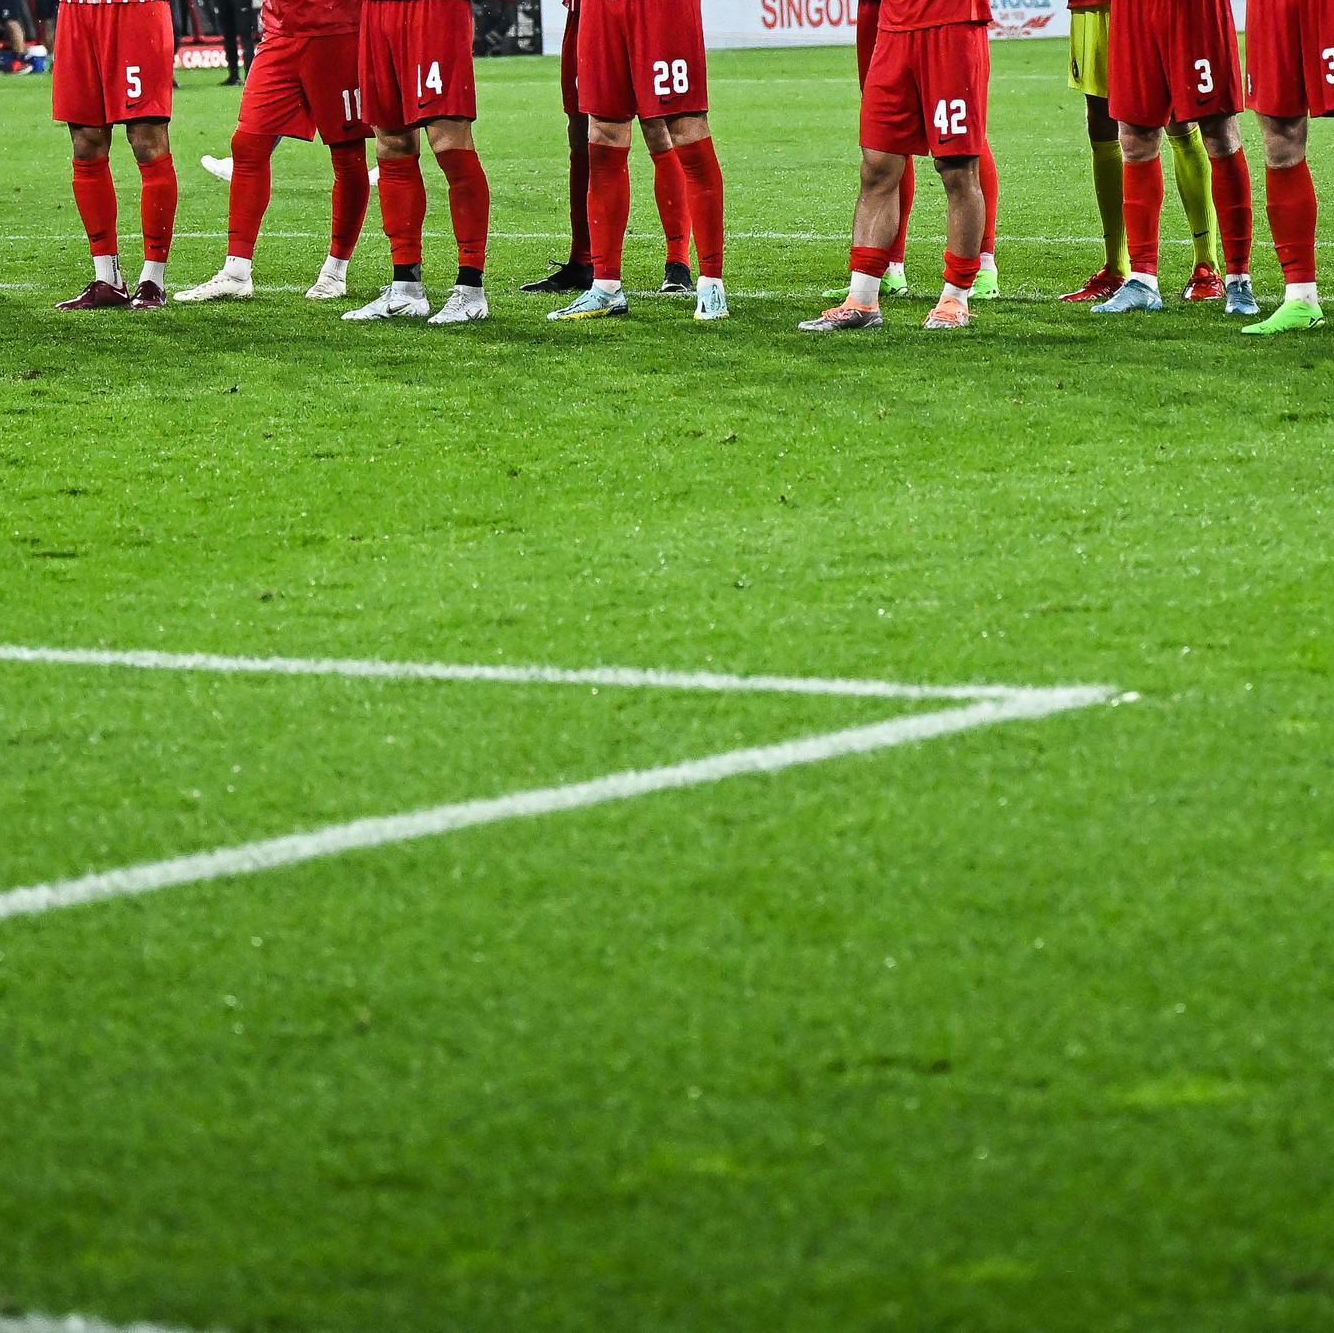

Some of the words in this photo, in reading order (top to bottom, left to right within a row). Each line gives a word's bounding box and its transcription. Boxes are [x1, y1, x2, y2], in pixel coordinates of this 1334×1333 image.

[126, 66, 141, 98] 5
[653, 59, 688, 96] 28
[1194, 58, 1214, 94] 3
[342, 88, 361, 121] 11
[933, 98, 967, 135] 42
